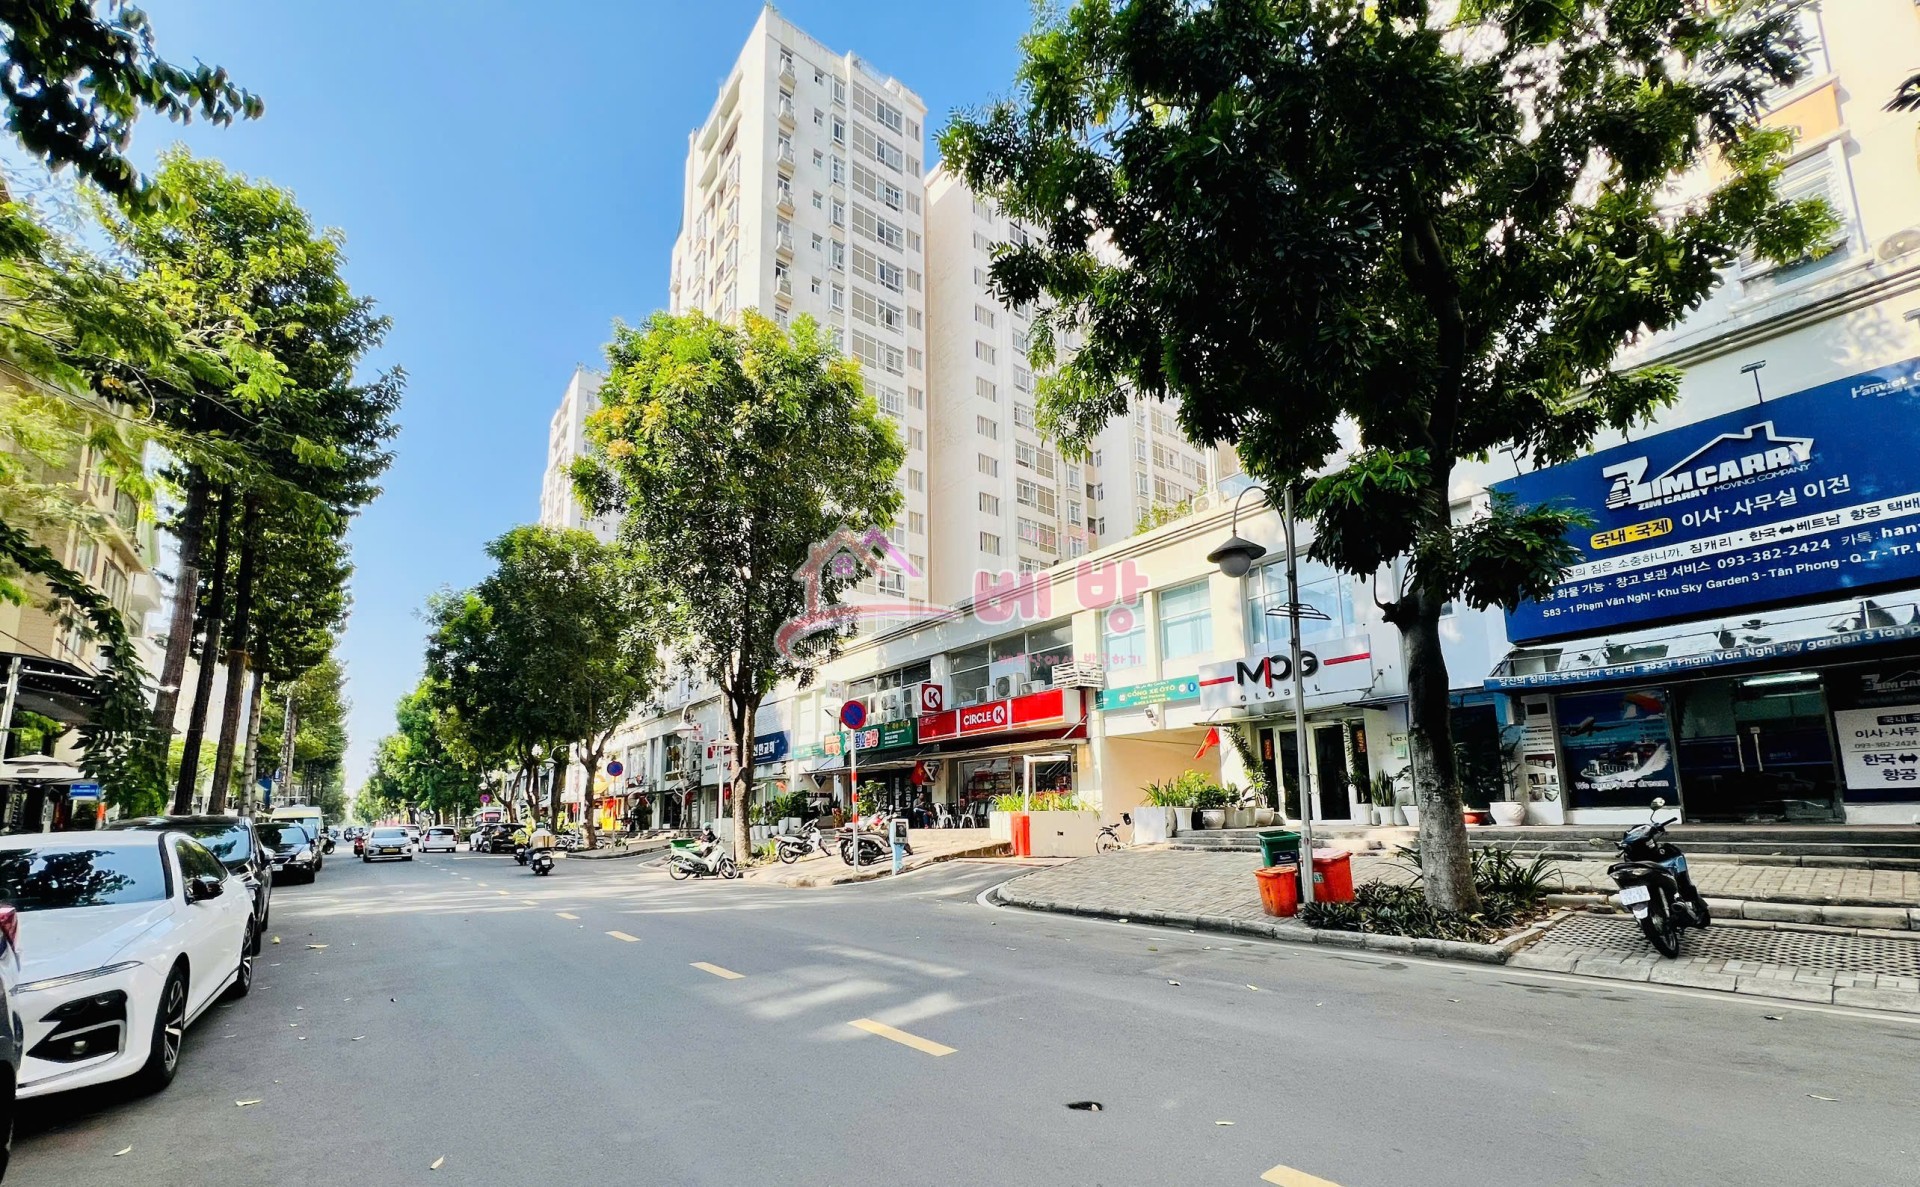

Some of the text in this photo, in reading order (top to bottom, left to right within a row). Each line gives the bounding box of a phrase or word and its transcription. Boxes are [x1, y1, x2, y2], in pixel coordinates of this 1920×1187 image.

[1851, 376, 1907, 398] Hanviet
[1696, 438, 1814, 488] CARRY
[1664, 487, 1708, 505] CARRY
[1714, 475, 1755, 493] MOVING
[1756, 462, 1811, 483] COMPANY
[1803, 473, 1851, 499] 이전
[1590, 561, 1613, 575] 짐은
[1690, 536, 1733, 554] 짐캐리
[1850, 505, 1882, 521] 항공
[1887, 496, 1920, 512] 택배
[1557, 586, 1580, 599] 화물
[1581, 581, 1605, 595] 가능
[1615, 574, 1641, 589] 창고
[1643, 568, 1668, 583] 보관
[1671, 560, 1712, 577] 서비스
[1717, 538, 1832, 570] 093-382-2424
[1576, 600, 1604, 613] Phạm
[1605, 596, 1626, 607] Văn
[1657, 586, 1680, 599] Khu
[1681, 582, 1703, 594] Sky
[1705, 573, 1749, 590] Garden
[1751, 571, 1760, 582] 3
[1769, 565, 1794, 579] Tân
[1796, 557, 1840, 574] Phong
[1715, 649, 1742, 662] Văn
[1745, 643, 1777, 657] Nghị
[1806, 632, 1861, 651] garden
[1864, 630, 1875, 640] 3
[1240, 684, 1321, 702] GLOBL
[963, 711, 992, 726] CIRCLE
[1854, 739, 1918, 749] 093-382-2424
[1862, 753, 1897, 766] 한국
[1882, 768, 1918, 781] 항공
